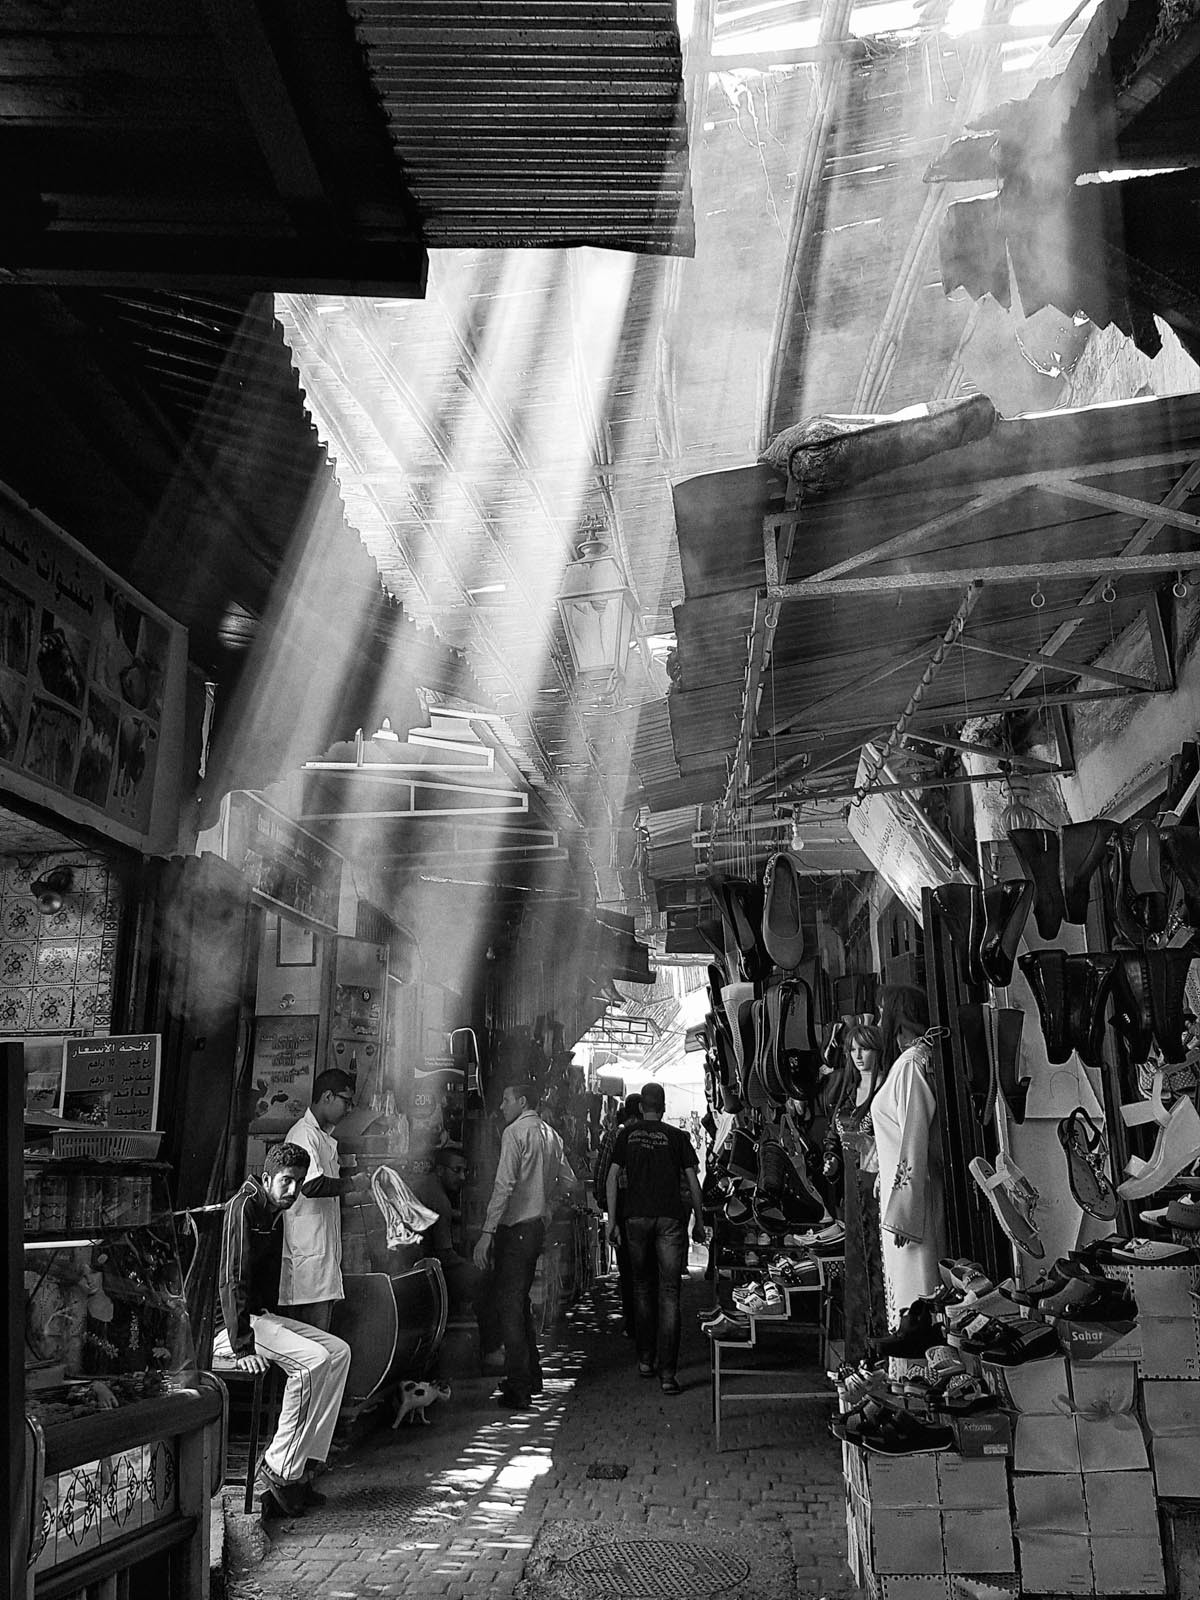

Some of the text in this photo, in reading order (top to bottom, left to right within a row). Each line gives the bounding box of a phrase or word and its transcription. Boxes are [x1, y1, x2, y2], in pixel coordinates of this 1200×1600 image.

[72, 1040, 151, 1057] لائحة الأسعار
[1071, 1330, 1103, 1341] Sahar
